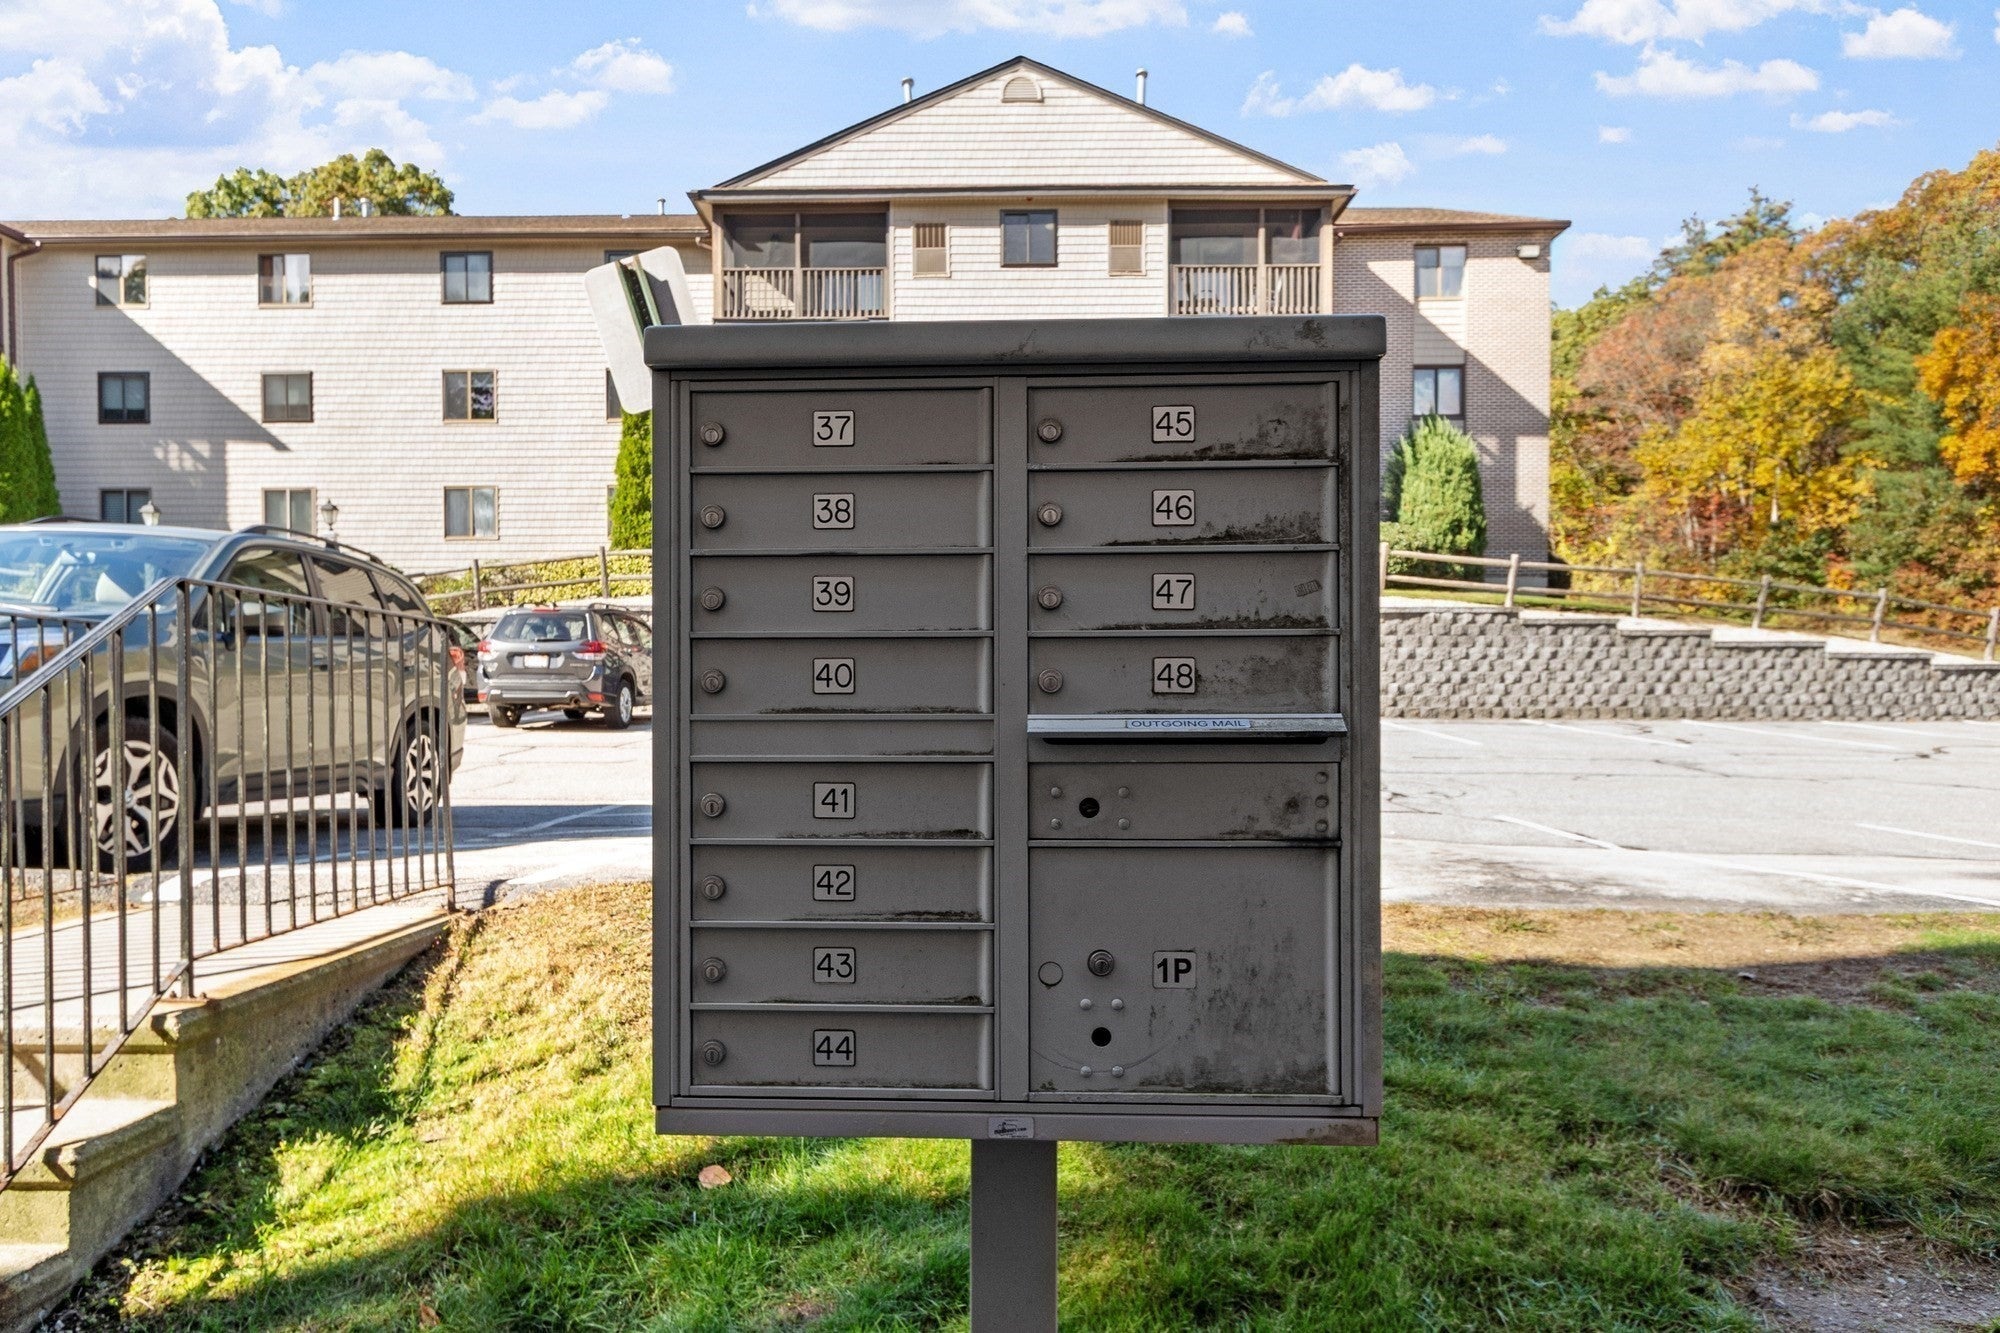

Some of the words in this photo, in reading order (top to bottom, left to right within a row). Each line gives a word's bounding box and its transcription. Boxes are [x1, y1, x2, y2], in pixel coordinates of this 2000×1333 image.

[817, 416, 850, 440] 37
[1156, 412, 1192, 436] 45
[817, 499, 850, 523] 38
[1156, 495, 1192, 520] 46
[816, 581, 850, 606] 39
[1156, 579, 1192, 604] 47
[816, 663, 852, 688] 40
[1157, 663, 1193, 688] 48
[1131, 720, 1208, 728] OUTGOING
[821, 788, 848, 812] 41
[817, 871, 851, 895] 42
[817, 953, 852, 978] 43
[1157, 958, 1191, 983] 1P
[816, 1036, 853, 1060] 44
